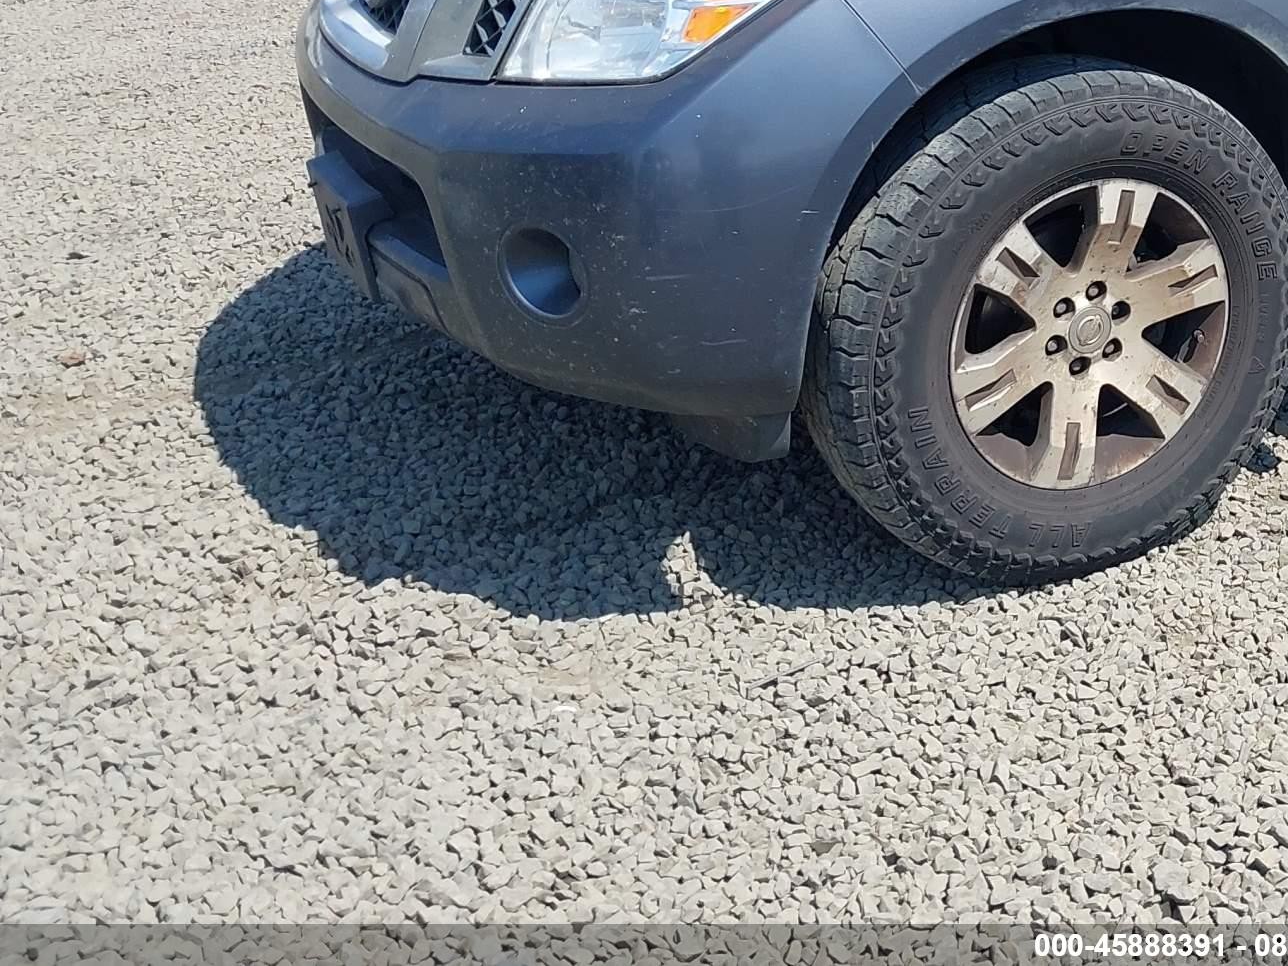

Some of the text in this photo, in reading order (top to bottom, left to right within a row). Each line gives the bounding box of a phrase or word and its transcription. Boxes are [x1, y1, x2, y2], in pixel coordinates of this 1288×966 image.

[1120, 131, 1279, 281] OPEN RANGE
[908, 405, 1094, 547] ALL TERRAIN
